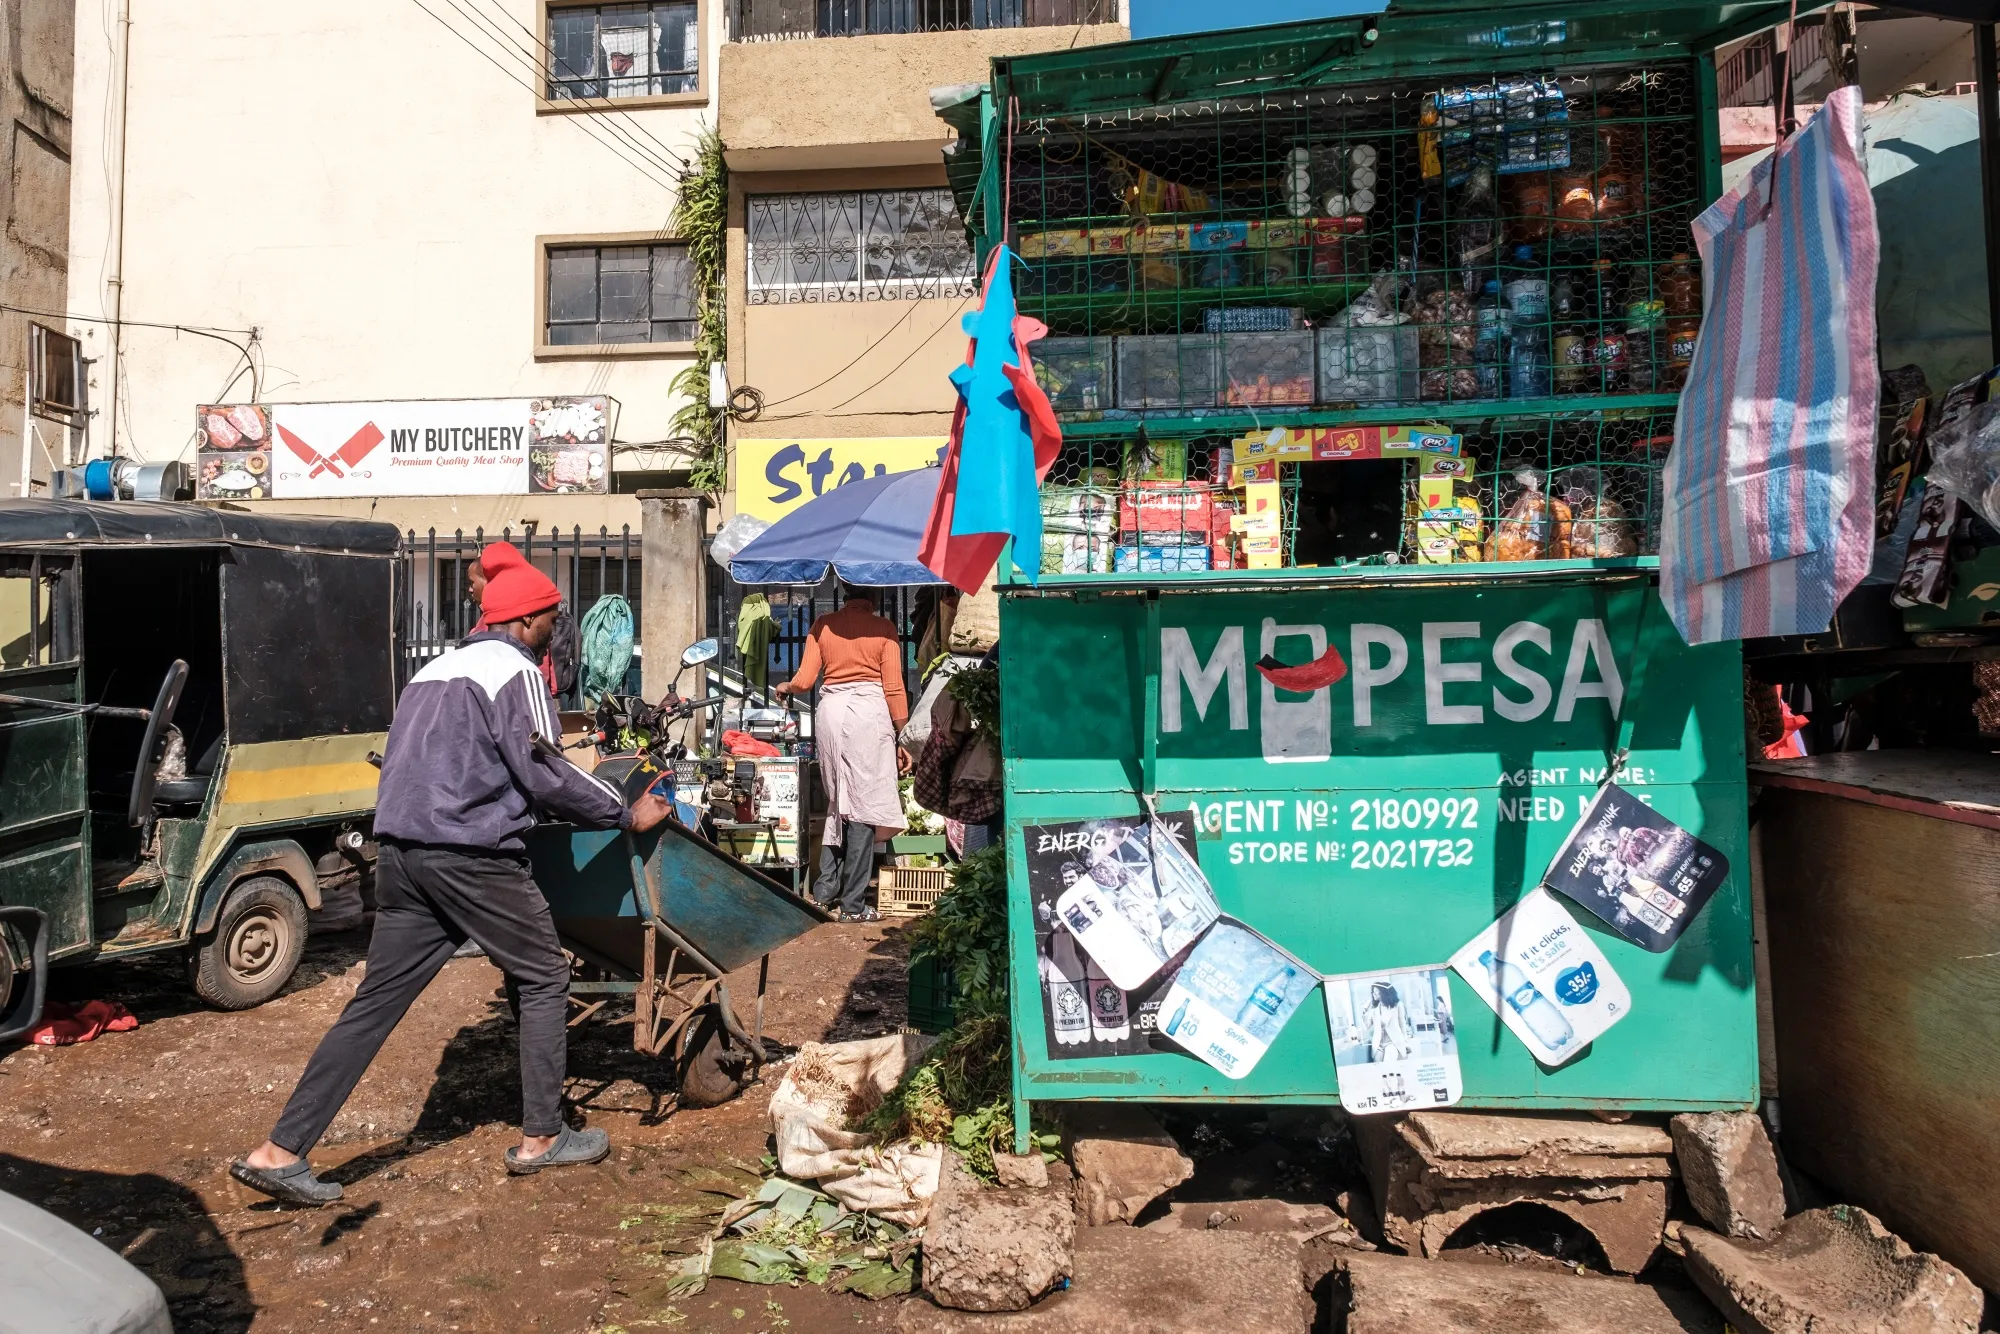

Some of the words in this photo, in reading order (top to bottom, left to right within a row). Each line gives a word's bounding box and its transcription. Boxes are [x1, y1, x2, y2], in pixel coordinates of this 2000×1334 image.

[1672, 342, 1697, 356] FANT
[390, 428, 419, 453] MY
[425, 426, 524, 452] BUTCHERY
[390, 456, 432, 466] Premium
[436, 455, 470, 467] Quality
[473, 455, 496, 465] Meat
[499, 454, 524, 466] Shop
[1216, 560, 1230, 568] 100
[1497, 767, 1570, 787] AGENT
[1187, 799, 1285, 834] AGENT
[1351, 797, 1479, 831] 2180992
[1497, 796, 1565, 822] NEED
[1593, 802, 1621, 837] DRINK
[1229, 842, 1308, 865] STORE
[1350, 839, 1474, 870] 2021732
[1677, 876, 1694, 893] 65
[1520, 951, 1531, 961] If
[1531, 945, 1540, 956] it
[1539, 924, 1571, 949] clicks,
[1544, 940, 1567, 957] safe
[1139, 1000, 1162, 1011] CHEZ
[1254, 988, 1280, 1010] Sprite
[1181, 1020, 1199, 1037] 40
[1224, 1026, 1250, 1046] Sprite
[1205, 1048, 1236, 1071] HAPPENS
[1209, 1042, 1240, 1065] HEAT
[1367, 1096, 1379, 1108] 75
